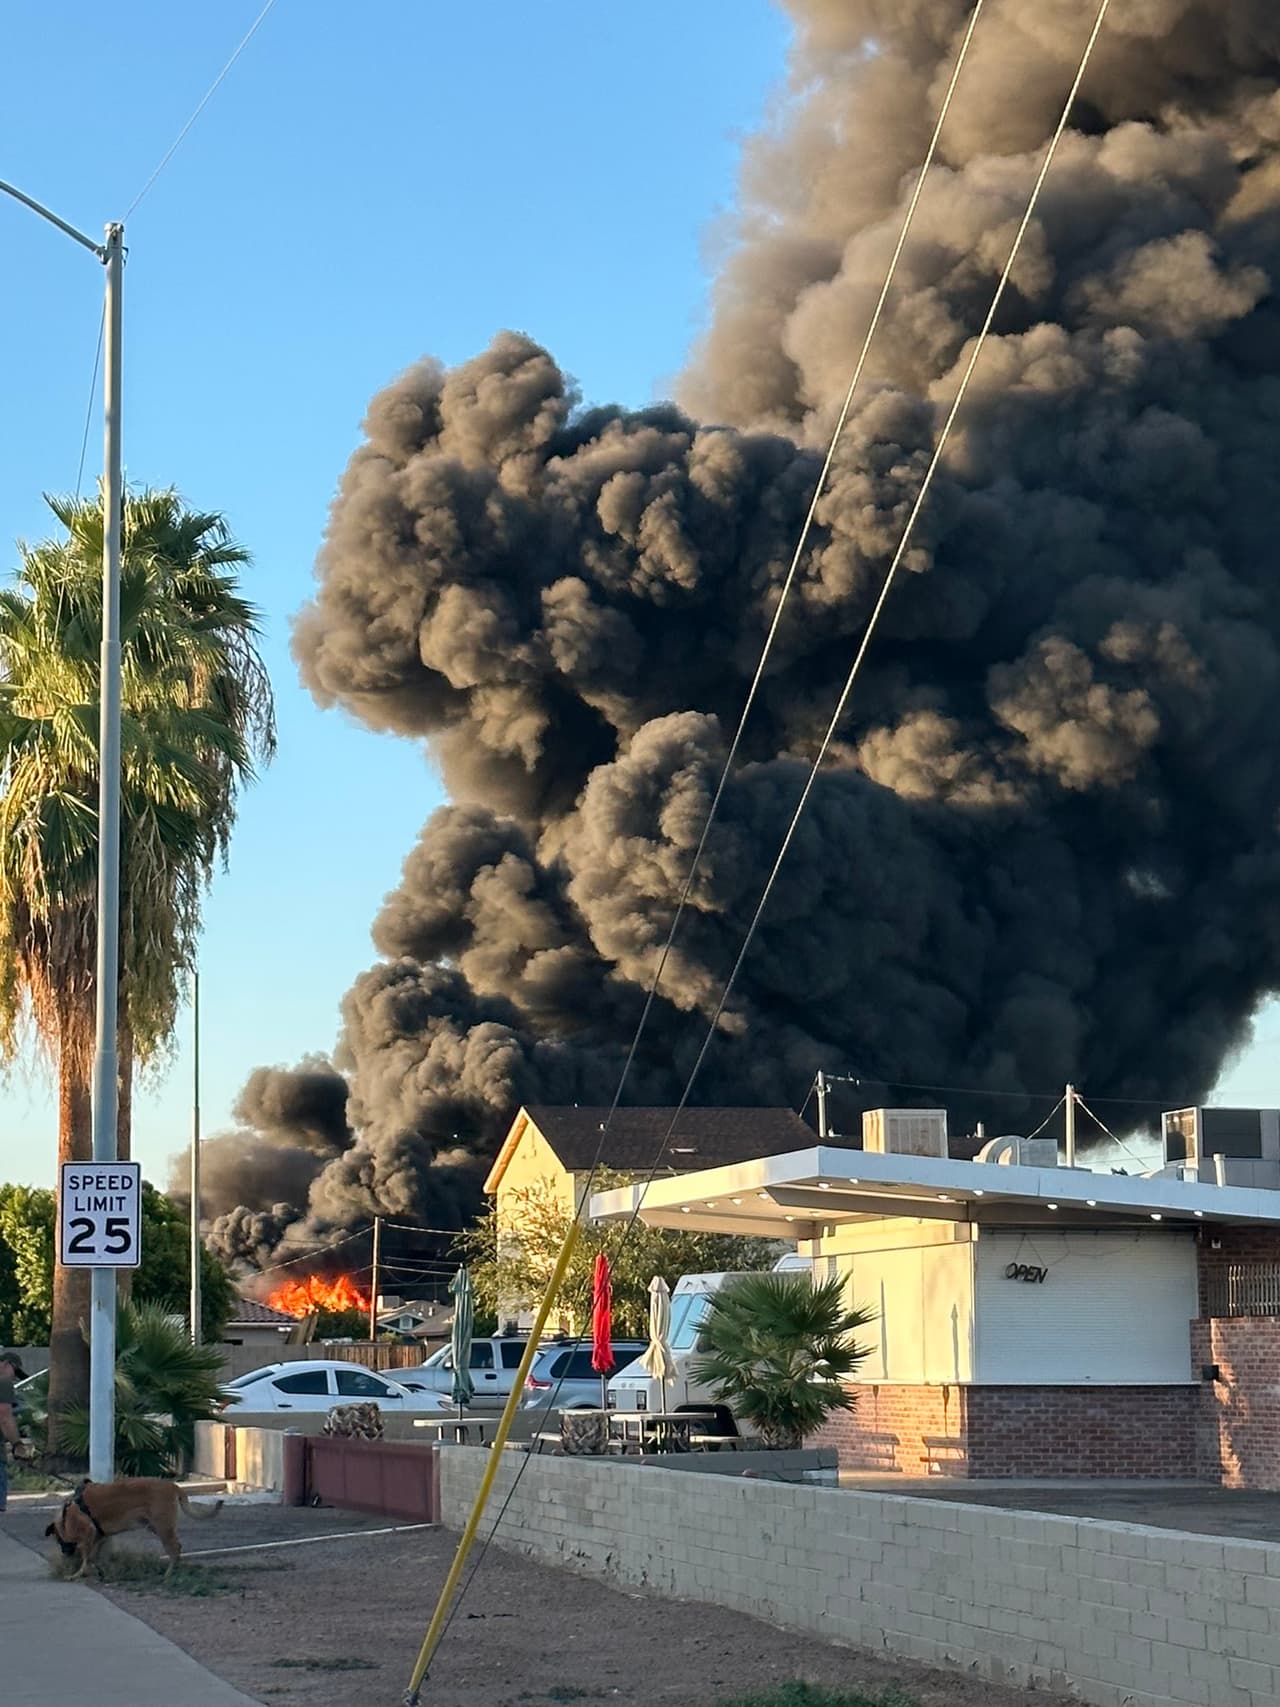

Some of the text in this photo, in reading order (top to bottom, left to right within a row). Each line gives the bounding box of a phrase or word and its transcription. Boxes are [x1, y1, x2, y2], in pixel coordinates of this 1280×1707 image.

[68, 1175, 133, 1190] SPEED
[74, 1196, 126, 1211] LIMIT
[68, 1217, 132, 1254] 25
[1006, 1262, 1049, 1284] OPEN
